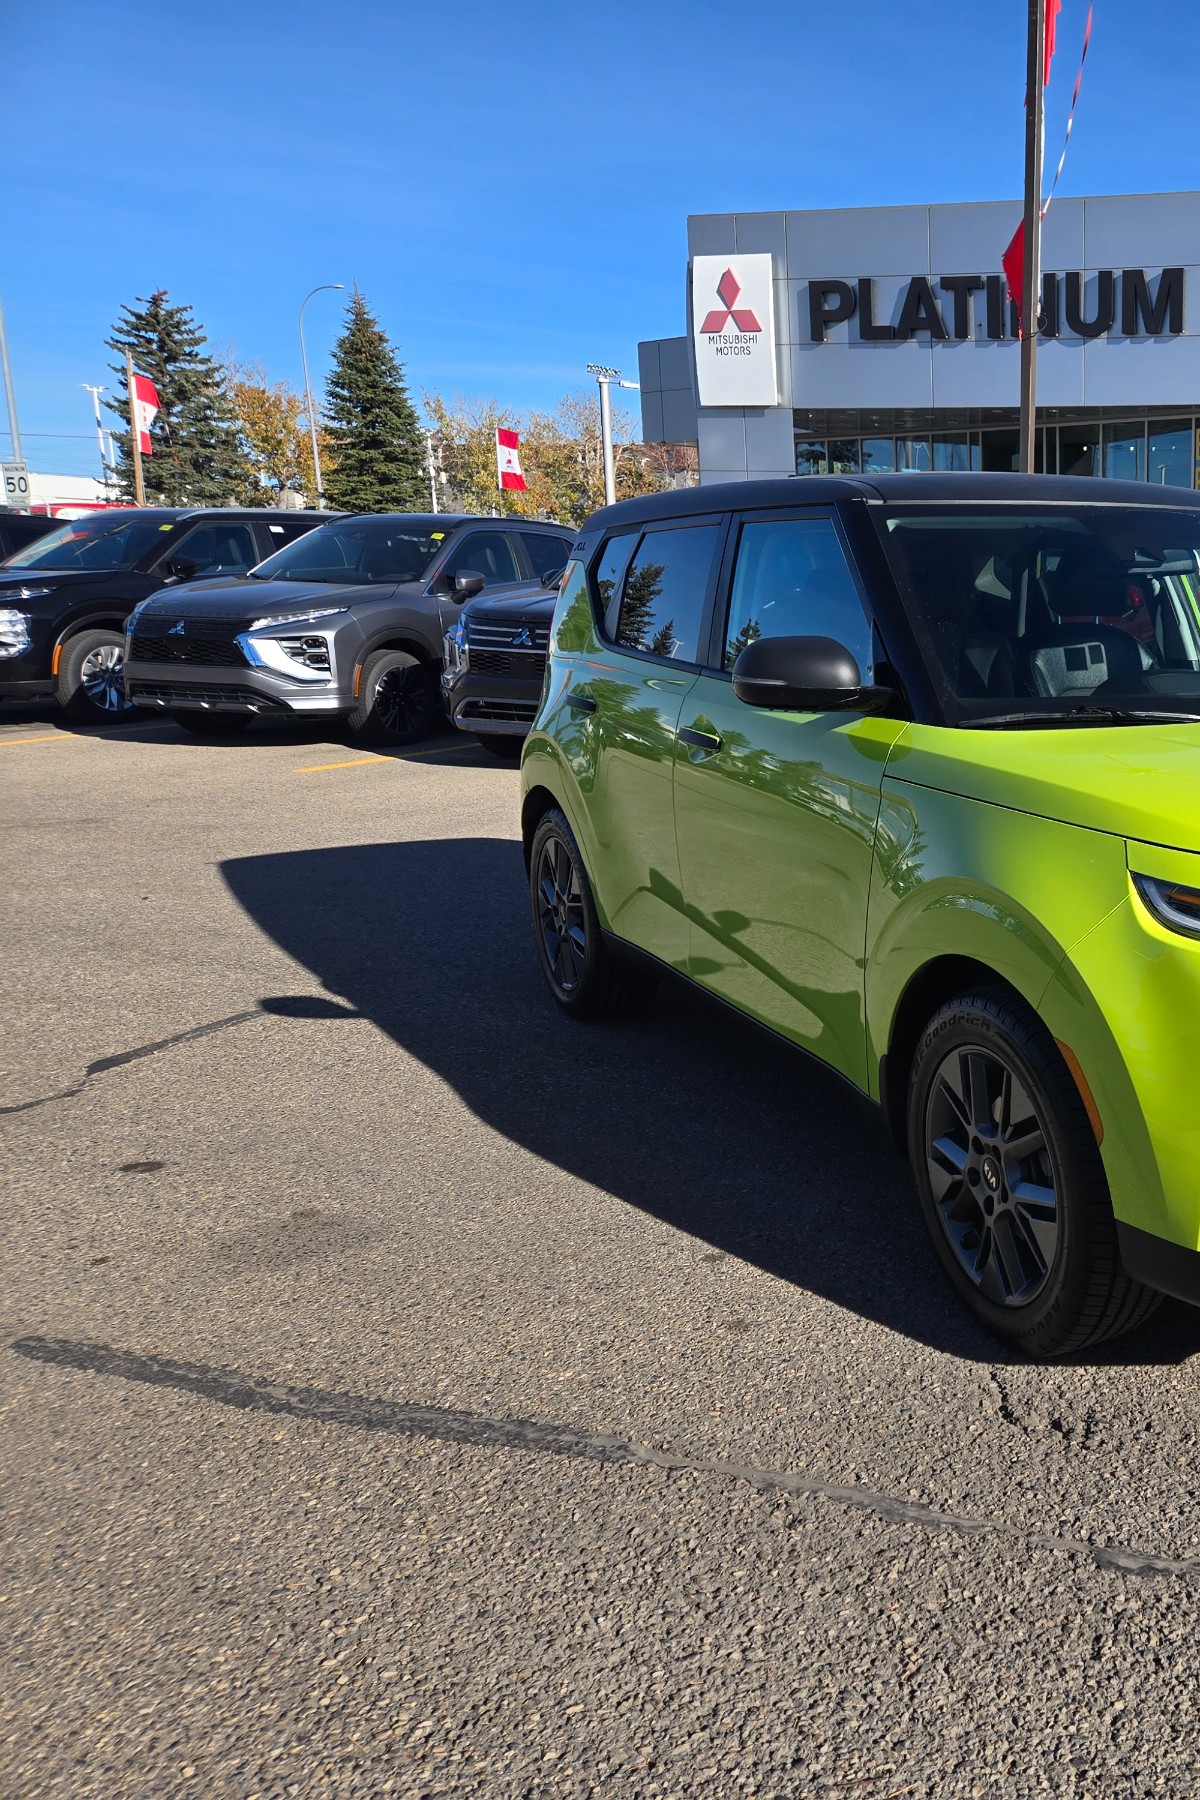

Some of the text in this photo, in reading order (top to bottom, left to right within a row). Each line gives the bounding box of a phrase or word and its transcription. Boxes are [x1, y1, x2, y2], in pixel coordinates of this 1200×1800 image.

[708, 334, 758, 345] MITSUBISHI
[715, 345, 752, 356] MOTORS
[6, 476, 27, 493] 50
